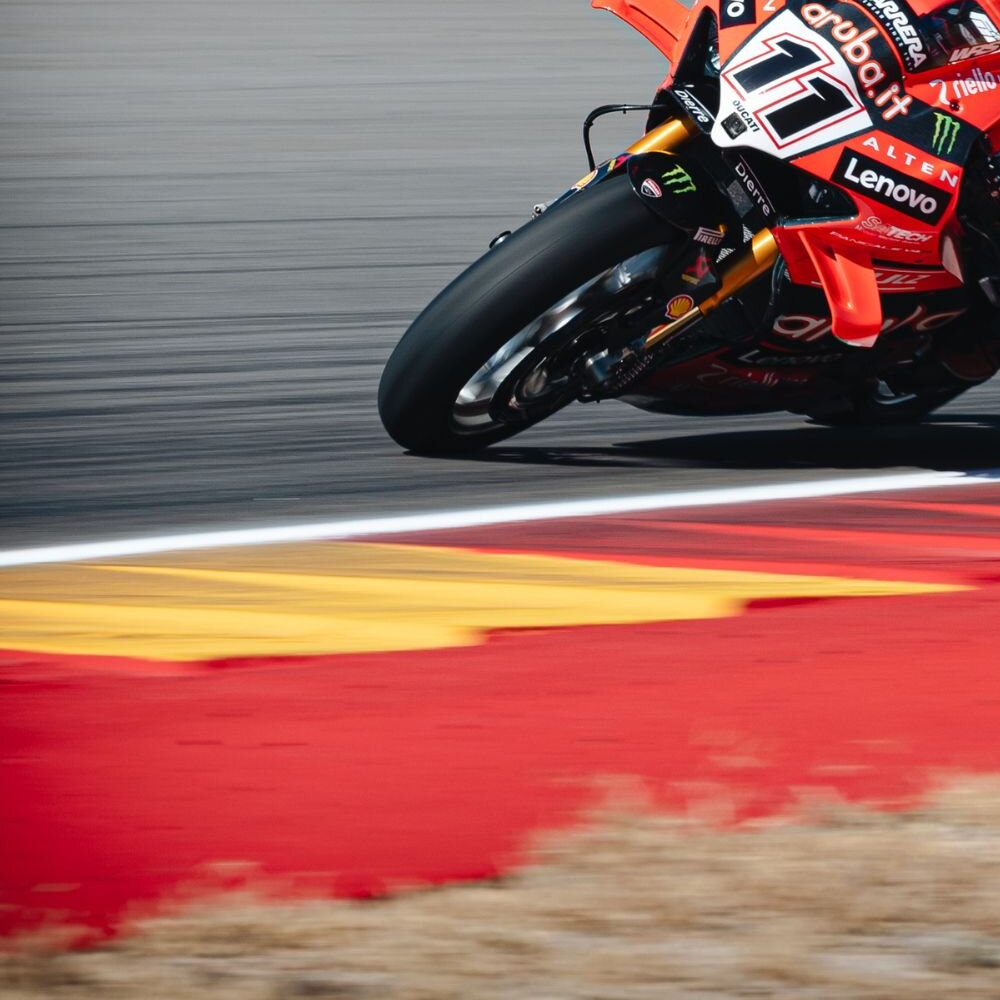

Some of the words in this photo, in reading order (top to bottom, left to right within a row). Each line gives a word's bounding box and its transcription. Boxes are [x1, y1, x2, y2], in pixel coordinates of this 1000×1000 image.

[801, 3, 912, 121] aruba.it
[952, 67, 996, 98] riello
[726, 35, 861, 146] 11
[732, 100, 760, 133] DUCATI
[843, 157, 938, 215] Lenovo
[862, 136, 959, 188] ALTEN
